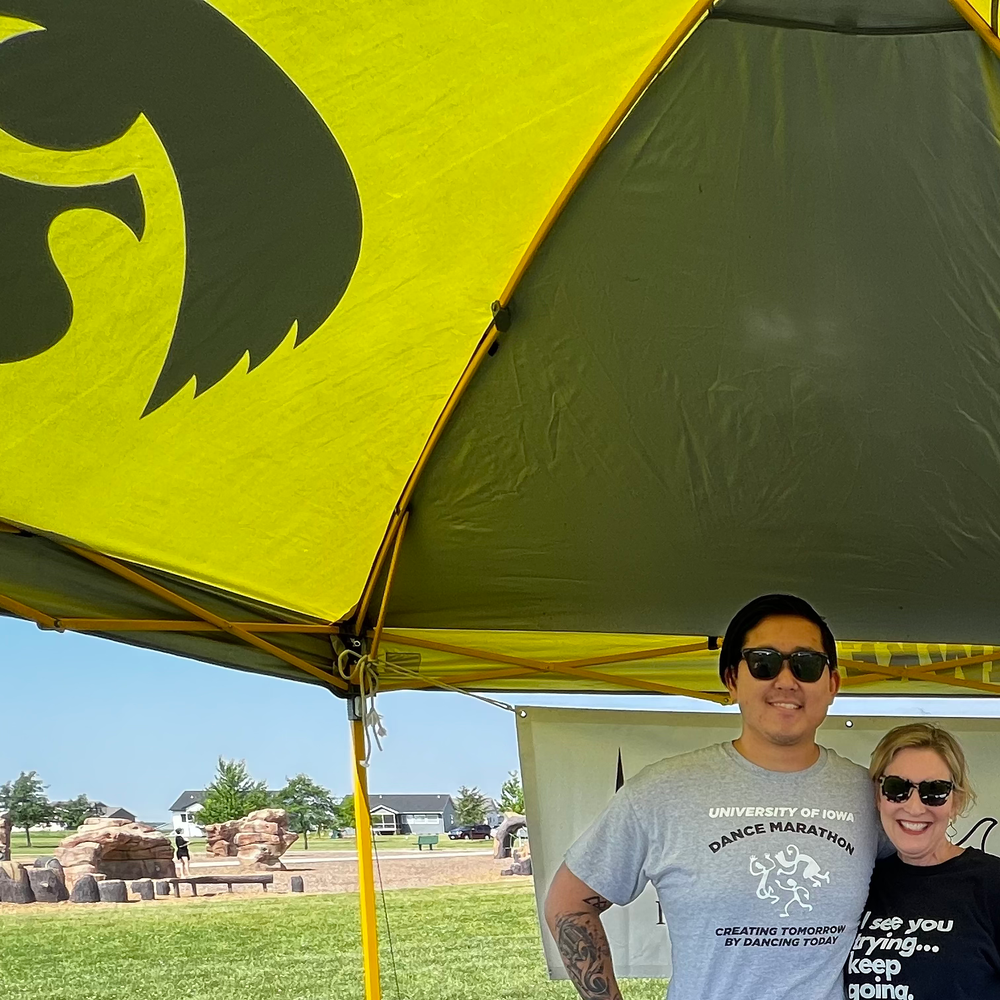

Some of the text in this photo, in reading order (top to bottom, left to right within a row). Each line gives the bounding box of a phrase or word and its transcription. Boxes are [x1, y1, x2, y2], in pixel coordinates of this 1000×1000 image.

[708, 806, 855, 823] UNIVERSITY OF IOWA
[708, 821, 855, 856] DANCE MARATHON
[715, 925, 847, 937] CREATING TOMORROW
[860, 910, 954, 935] I see you
[724, 936, 839, 947] BY DANCING TODAY
[852, 932, 940, 957] trying...
[848, 950, 902, 982] keep
